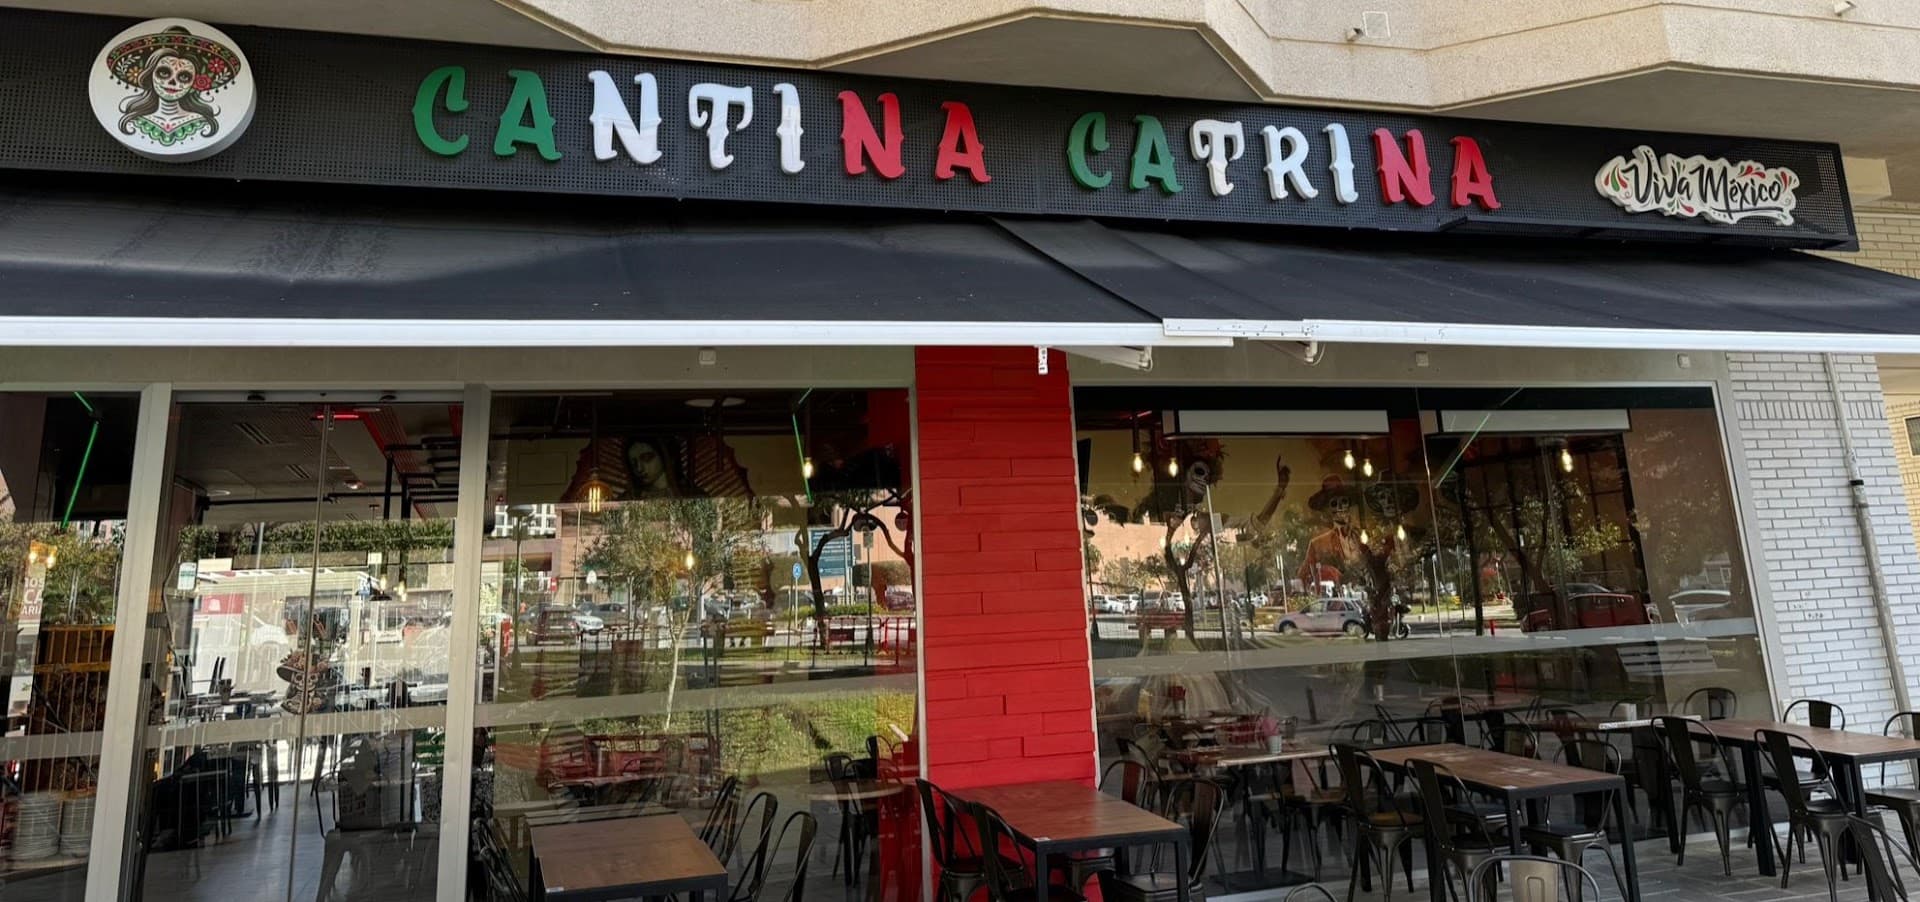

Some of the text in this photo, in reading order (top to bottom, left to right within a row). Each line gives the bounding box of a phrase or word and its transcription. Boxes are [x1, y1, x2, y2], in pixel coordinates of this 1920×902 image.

[412, 65, 1502, 210] CANTINA CATRINA
[1620, 148, 1783, 219] Viva México
